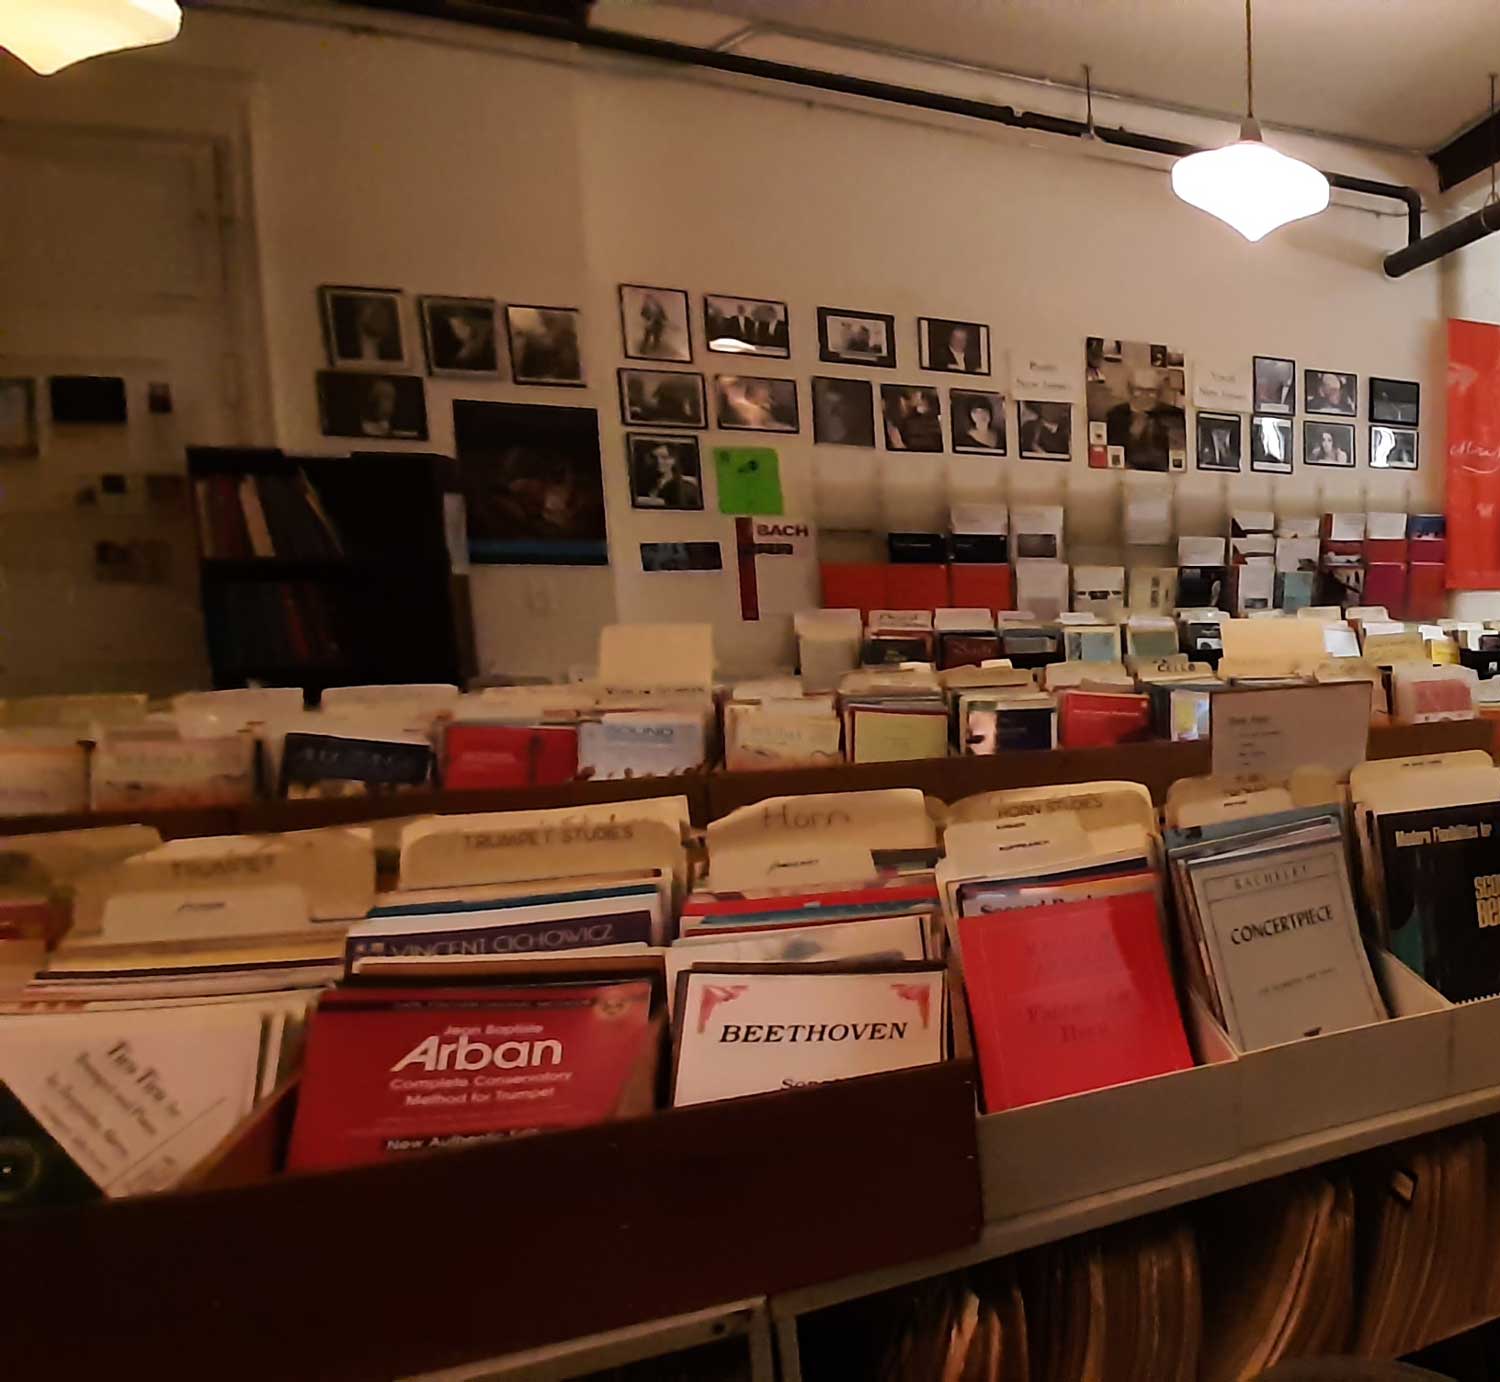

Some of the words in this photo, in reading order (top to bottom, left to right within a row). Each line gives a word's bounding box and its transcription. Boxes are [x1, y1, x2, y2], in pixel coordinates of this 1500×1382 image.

[757, 524, 809, 537] BACH
[762, 803, 851, 832] Horn
[1230, 904, 1334, 945] CONCERTPIECE
[719, 1022, 909, 1044] BEETHOVEN
[389, 1034, 563, 1073] Arban
[388, 1077, 470, 1092] Complete
[405, 1092, 468, 1107] Method
[470, 1091, 491, 1104] for
